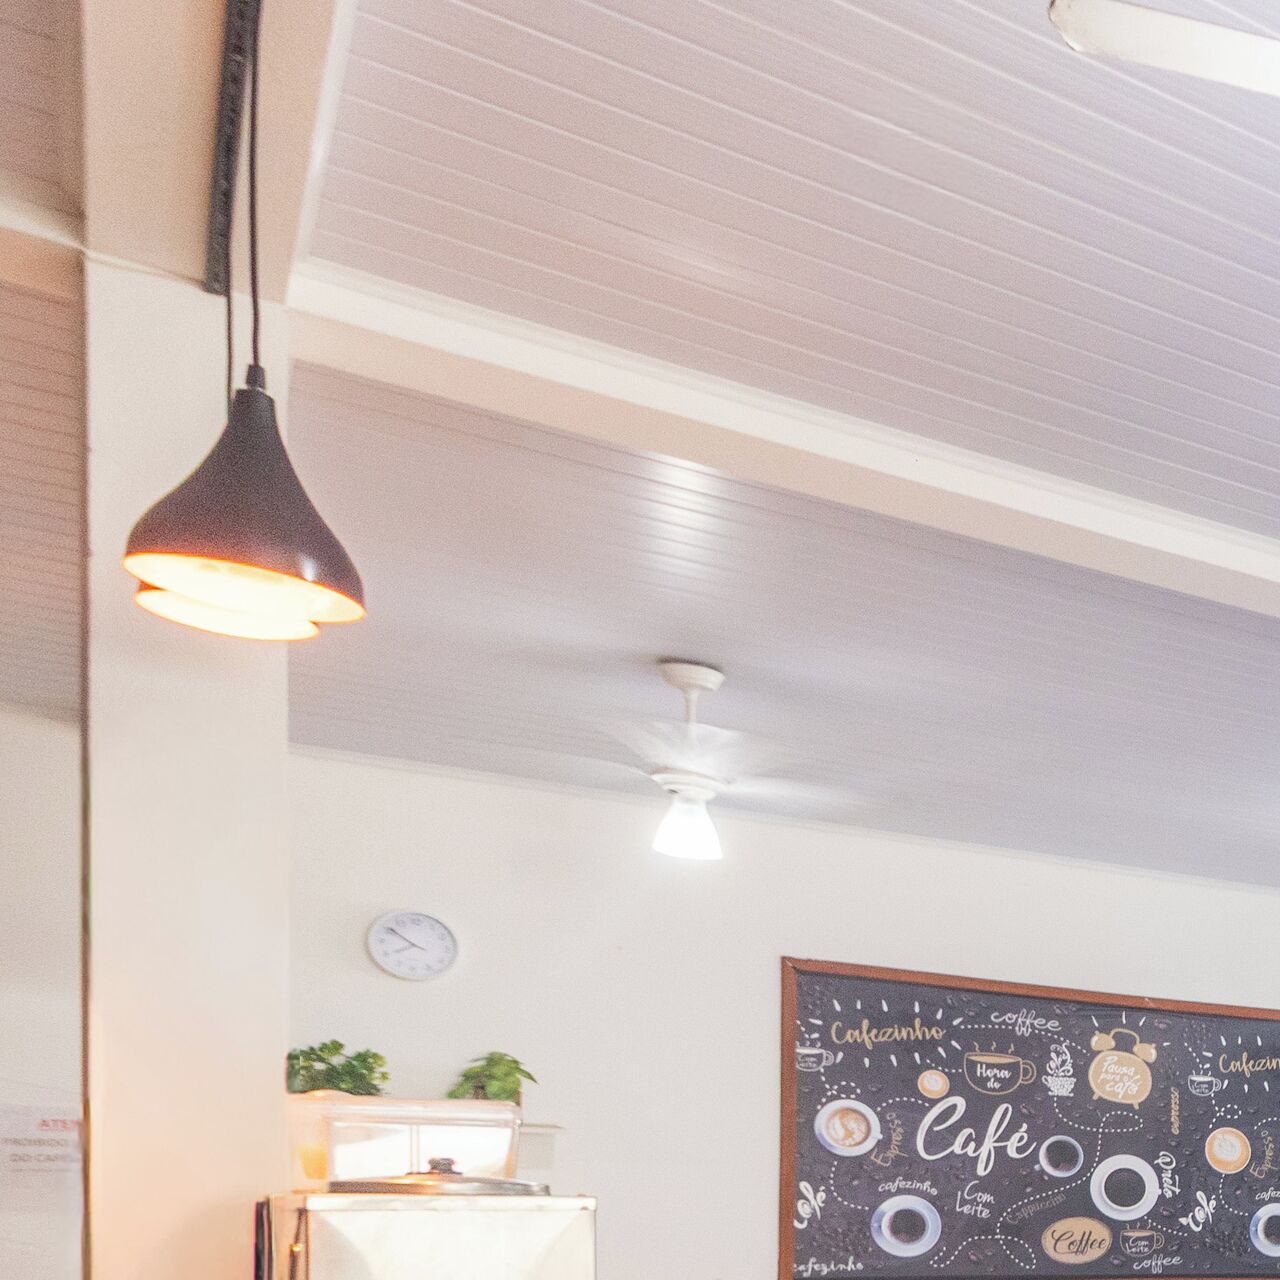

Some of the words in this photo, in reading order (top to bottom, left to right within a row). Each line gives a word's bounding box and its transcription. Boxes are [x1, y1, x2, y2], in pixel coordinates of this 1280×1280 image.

[831, 1017, 946, 1050] Cafezinho
[991, 1008, 1062, 1037] coffee
[976, 1063, 1012, 1079] Hora
[1101, 1055, 1136, 1075] Pausa
[987, 1078, 1001, 1090] do
[1105, 1075, 1143, 1099] café
[916, 1095, 1037, 1177] Café
[878, 1176, 938, 1196] cafezinho
[1154, 1151, 1182, 1199] Preto
[963, 1181, 996, 1204] Com
[955, 1191, 992, 1219] Leite
[1051, 1229, 1107, 1257] Coffee
[1129, 1236, 1150, 1246] Com
[1133, 1254, 1183, 1273] coffee
